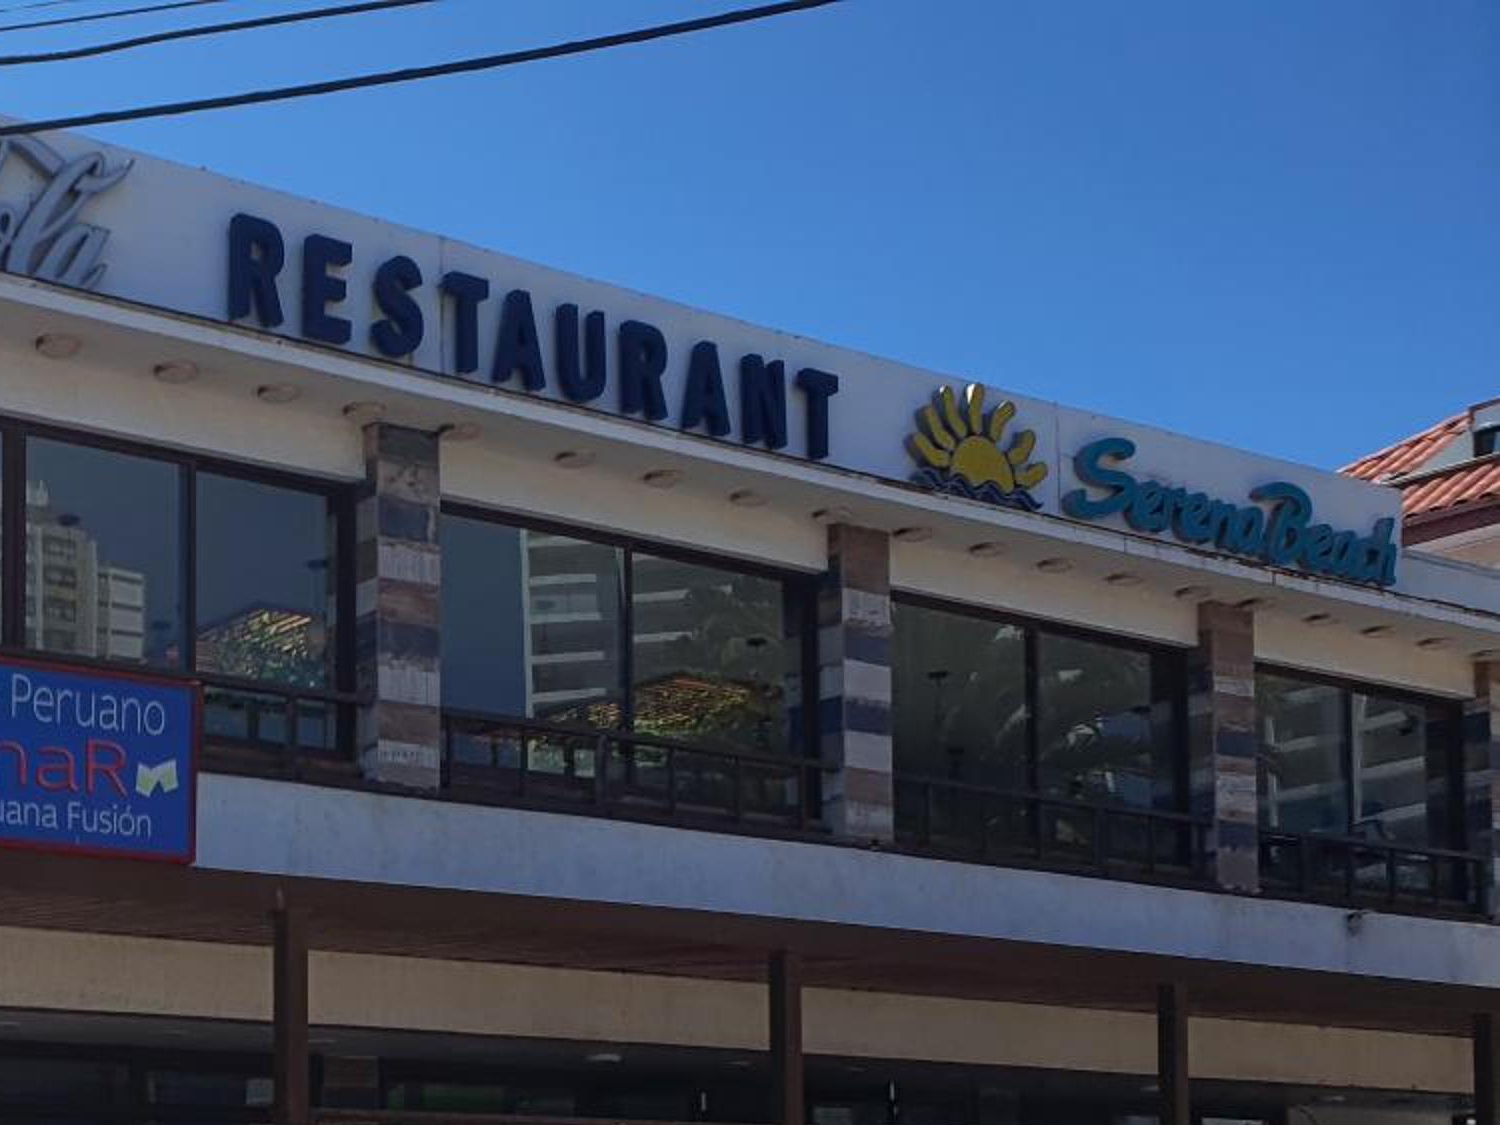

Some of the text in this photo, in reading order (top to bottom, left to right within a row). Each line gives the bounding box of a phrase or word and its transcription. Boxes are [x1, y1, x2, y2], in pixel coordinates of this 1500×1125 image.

[228, 212, 840, 461] RESTAURANT
[1061, 436, 1266, 558] Serena
[10, 673, 166, 737] Peruano
[67, 801, 152, 839] Fusión
